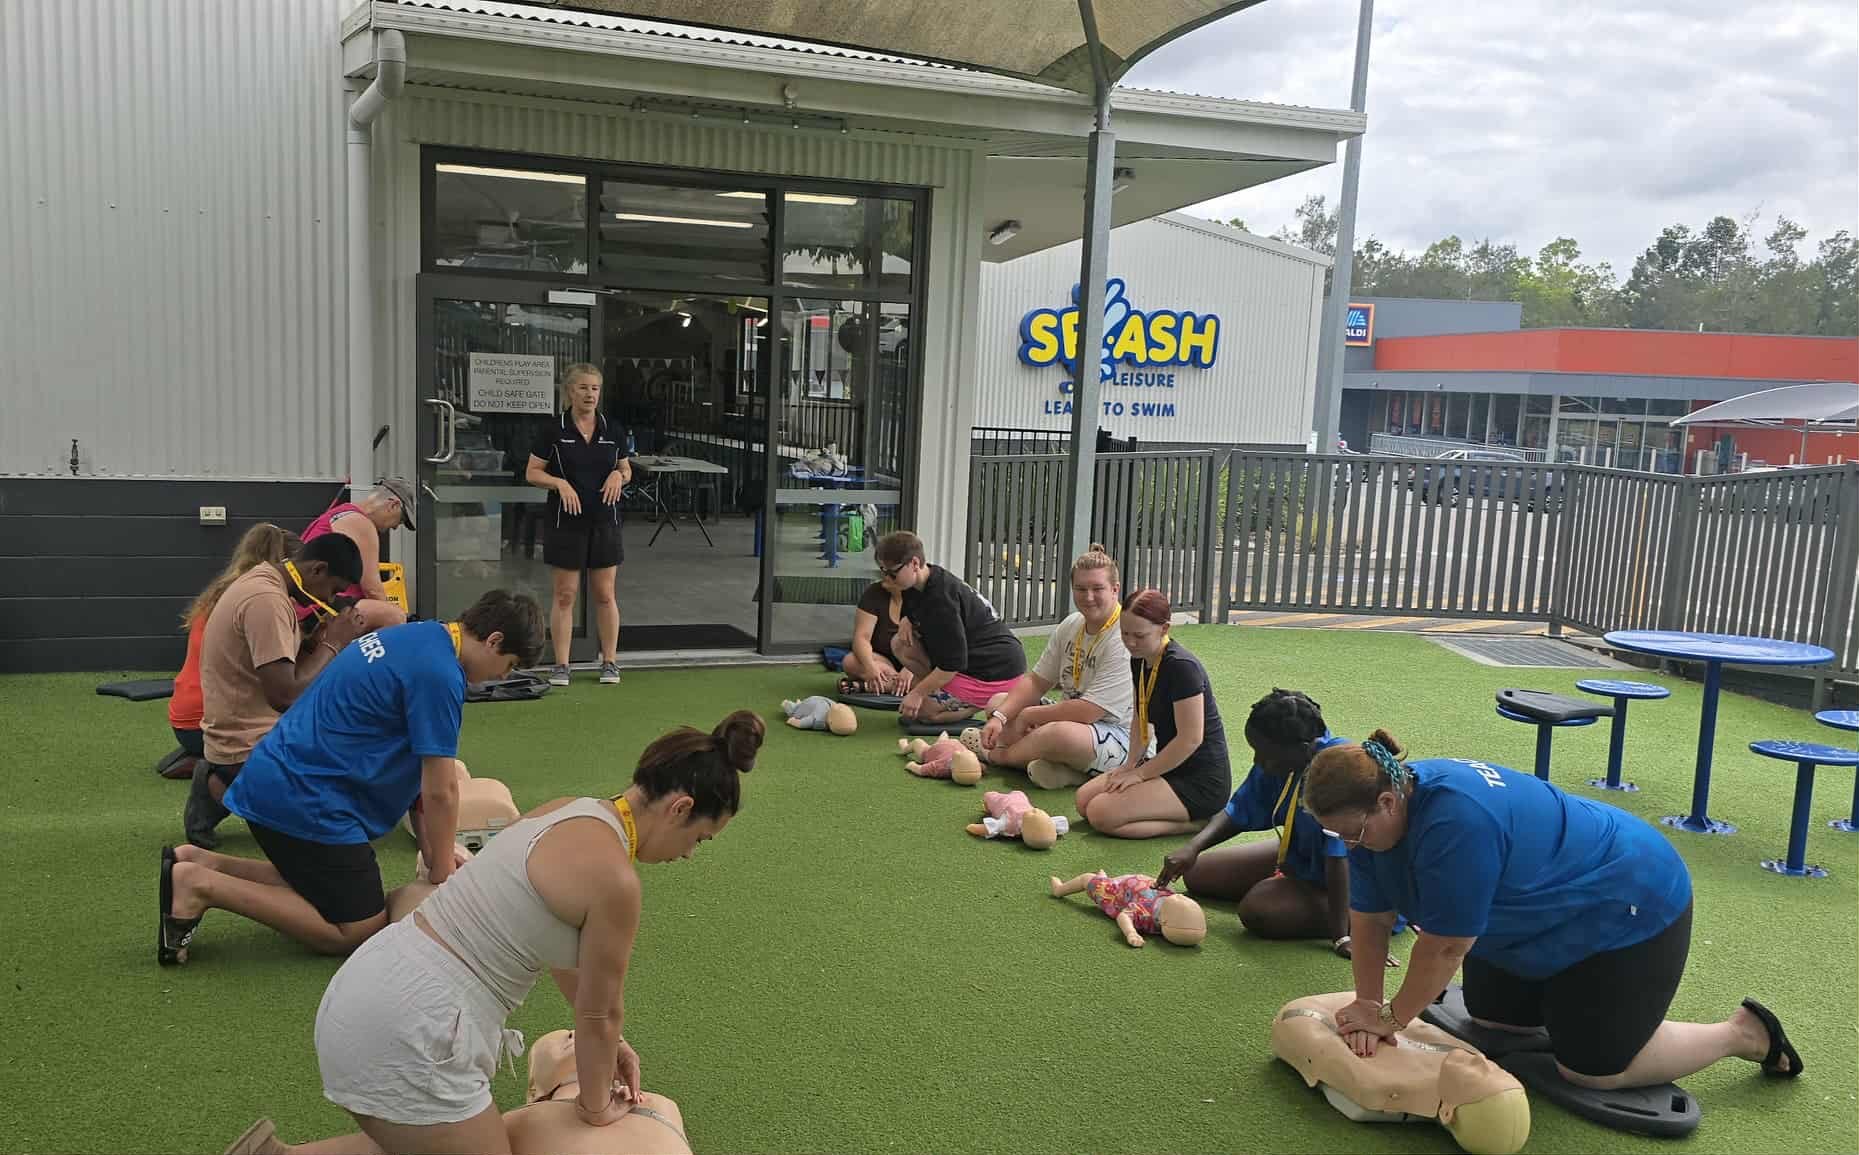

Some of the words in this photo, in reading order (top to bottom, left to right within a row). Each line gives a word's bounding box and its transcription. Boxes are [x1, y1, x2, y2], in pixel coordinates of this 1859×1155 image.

[1020, 308, 1220, 369] SPASH
[515, 360, 531, 368] PLAY
[531, 360, 551, 369] AREA
[473, 367, 509, 376] PARENTAL
[509, 369, 551, 377] SUPERVISION
[495, 378, 530, 386] REQUIRED
[1113, 372, 1175, 388] LEISURE
[478, 389, 502, 398] CHILD
[504, 390, 524, 399] SAFE
[526, 391, 545, 399] GATE
[473, 400, 487, 408] DO
[488, 400, 504, 408] NOT
[507, 401, 527, 409] KEEP
[529, 401, 551, 409] OPEN
[1045, 400, 1074, 415] LEA
[1103, 401, 1124, 416] TO
[1131, 402, 1175, 417] SWIM
